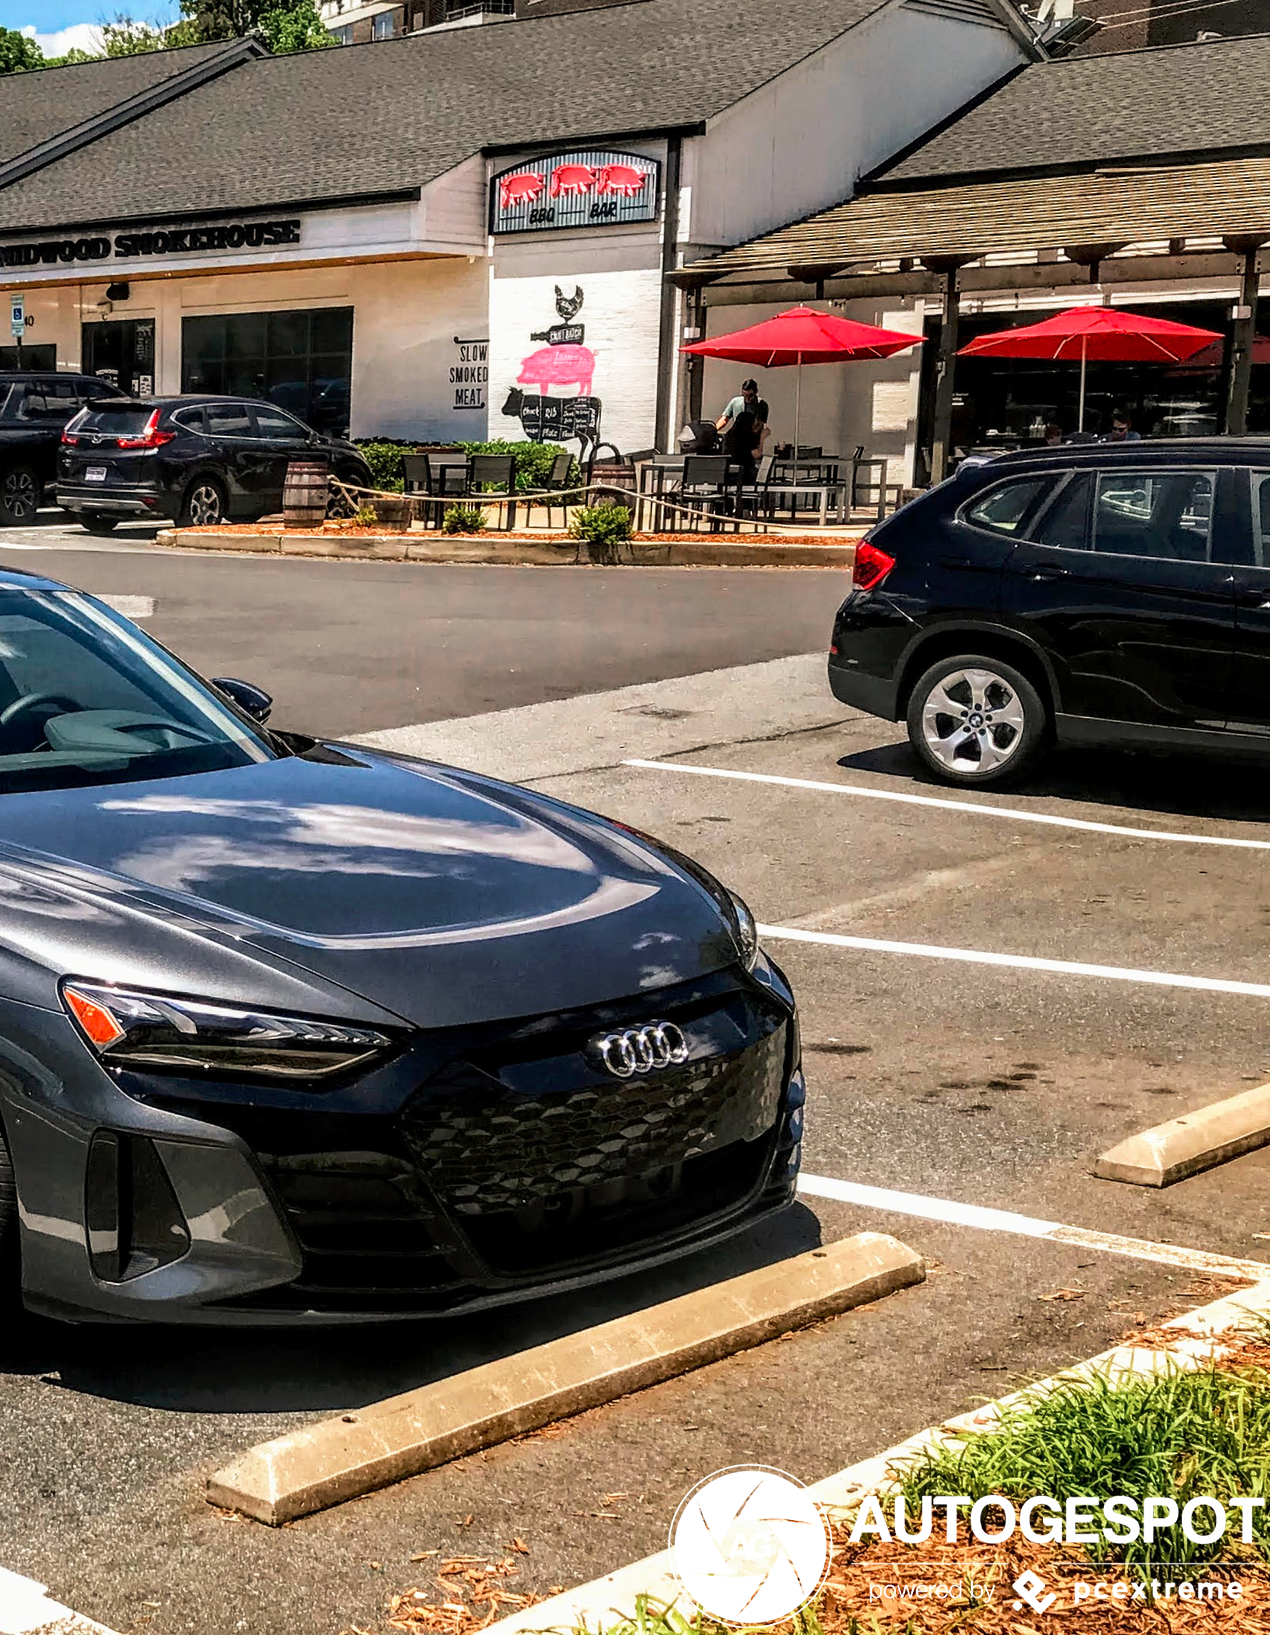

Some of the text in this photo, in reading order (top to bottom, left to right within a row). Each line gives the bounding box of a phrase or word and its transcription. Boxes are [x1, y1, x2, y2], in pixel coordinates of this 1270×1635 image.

[529, 201, 617, 224] BBQ BAR
[115, 219, 301, 258] SMOKEHOUSE
[460, 345, 487, 362] SLOW
[450, 366, 488, 383] SMOKED
[455, 388, 482, 405] MEAT
